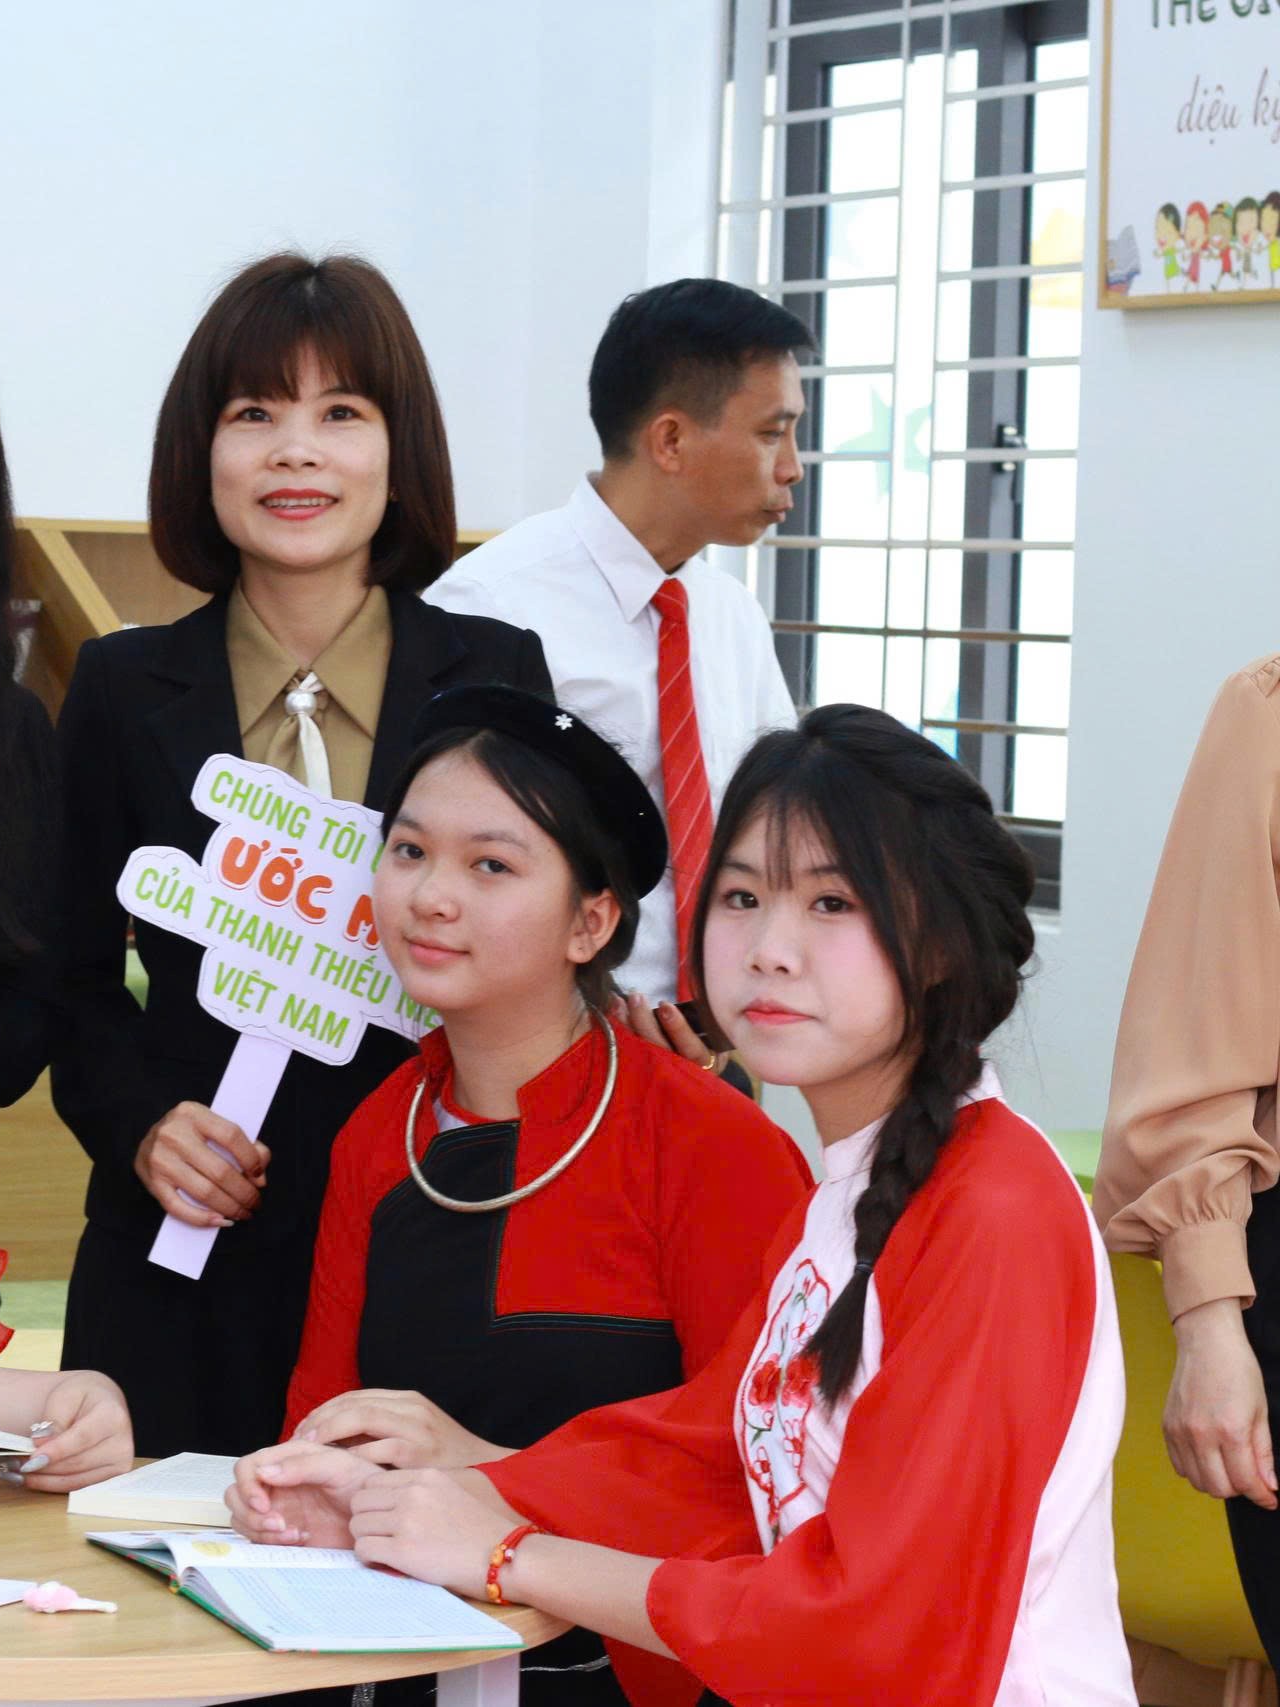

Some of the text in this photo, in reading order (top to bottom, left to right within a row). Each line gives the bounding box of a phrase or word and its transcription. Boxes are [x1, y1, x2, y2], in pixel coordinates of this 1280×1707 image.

[1176, 73, 1238, 146] diệu
[209, 770, 311, 840] CHÚNG
[318, 816, 367, 864] TÔI
[221, 837, 333, 921] ƯỚC
[135, 866, 194, 919] CỦA
[206, 896, 303, 965] THANH
[309, 943, 392, 1004] THIẾU
[213, 963, 350, 1048] VIỆT NAM
